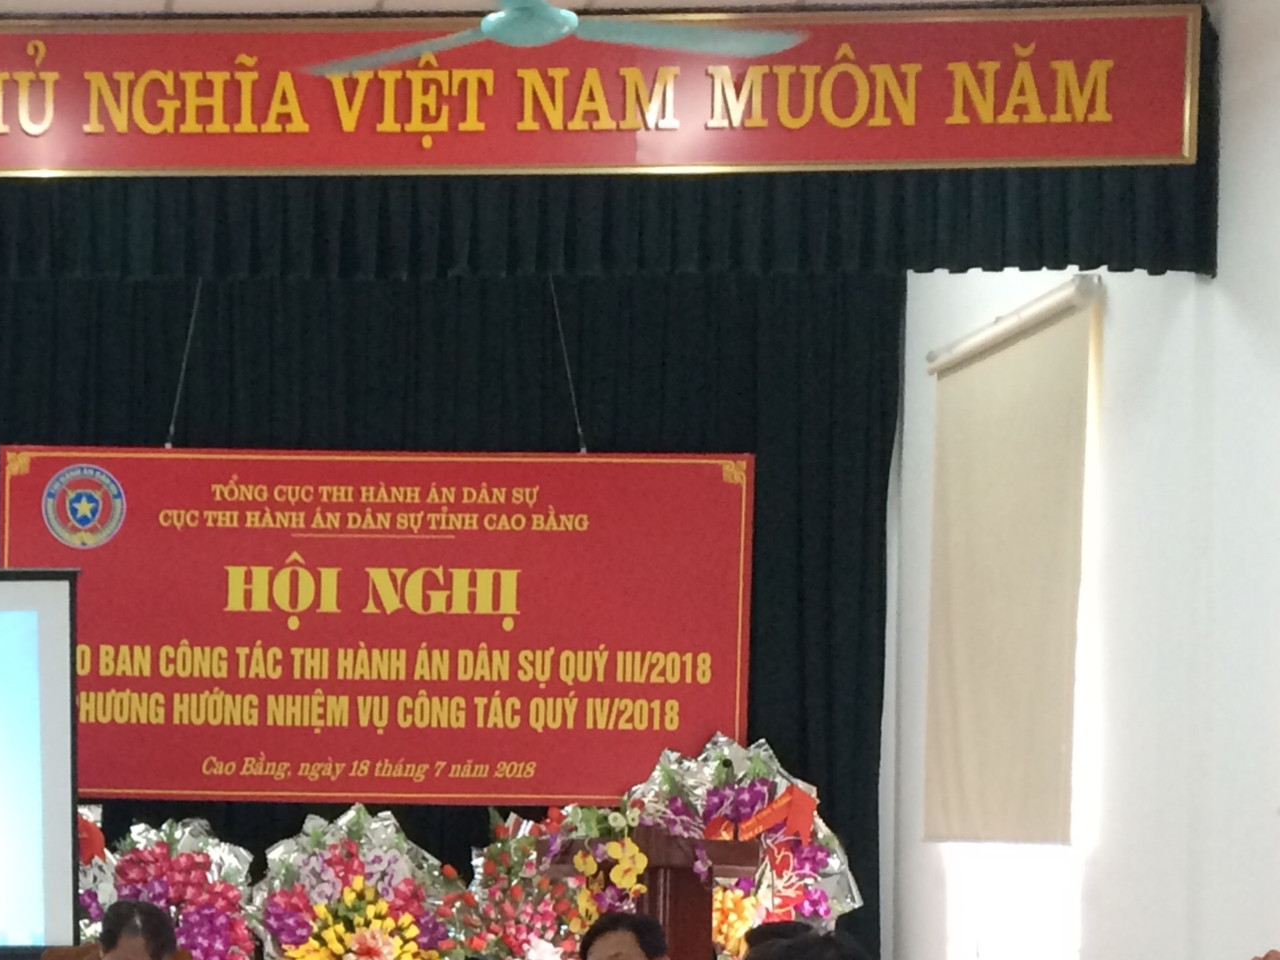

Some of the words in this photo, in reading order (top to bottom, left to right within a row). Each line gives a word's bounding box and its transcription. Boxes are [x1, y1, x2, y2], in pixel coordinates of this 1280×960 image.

[83, 55, 309, 135] NGHĨA
[326, 54, 494, 149] VIỆT
[517, 65, 681, 132] NAM
[704, 42, 923, 130] MUÔN
[946, 41, 1114, 124] NĂM
[211, 473, 268, 501] TỔNG
[273, 485, 314, 505] CỤC
[319, 485, 354, 502] THI
[360, 481, 421, 504] HÀNH
[426, 481, 456, 504] ÁN
[462, 482, 506, 504] DÂN
[511, 485, 539, 508] SỰ
[158, 509, 199, 531] CỤC
[204, 510, 239, 528] THI
[245, 506, 306, 528] HÀNH
[311, 506, 341, 529] ÁN
[346, 507, 391, 529] DÂN
[396, 510, 424, 534] SỰ
[427, 505, 479, 531] TỈNH
[483, 513, 526, 531] CAO
[531, 505, 589, 531] BẰNG
[223, 550, 342, 631] HỘI
[361, 565, 522, 632] NGHỊ
[99, 644, 151, 677] BAN
[159, 639, 228, 679] CÔNG
[236, 640, 283, 679] TÁC
[290, 647, 329, 680] THI
[337, 640, 406, 681] HÀNH
[414, 642, 449, 681] ÁN
[457, 642, 510, 681] DÂN
[517, 646, 555, 689] SỰ
[559, 644, 609, 685] QUÝ
[616, 650, 712, 684] III/2018
[76, 688, 166, 725] HƯƠNG
[173, 686, 259, 726] HƯỚNG
[266, 688, 349, 734] NHIỆM
[357, 695, 389, 735] VỤ
[397, 689, 466, 729] CÔNG
[474, 690, 521, 729] TÁC
[529, 690, 578, 733] QUÝ
[586, 698, 680, 731] IV/2018
[202, 756, 236, 776] Cao
[298, 757, 346, 780] ngày
[349, 759, 370, 777] 18
[374, 757, 429, 782] tháng
[434, 760, 443, 778] 7
[448, 759, 489, 778] năm
[493, 761, 536, 778] 2018
